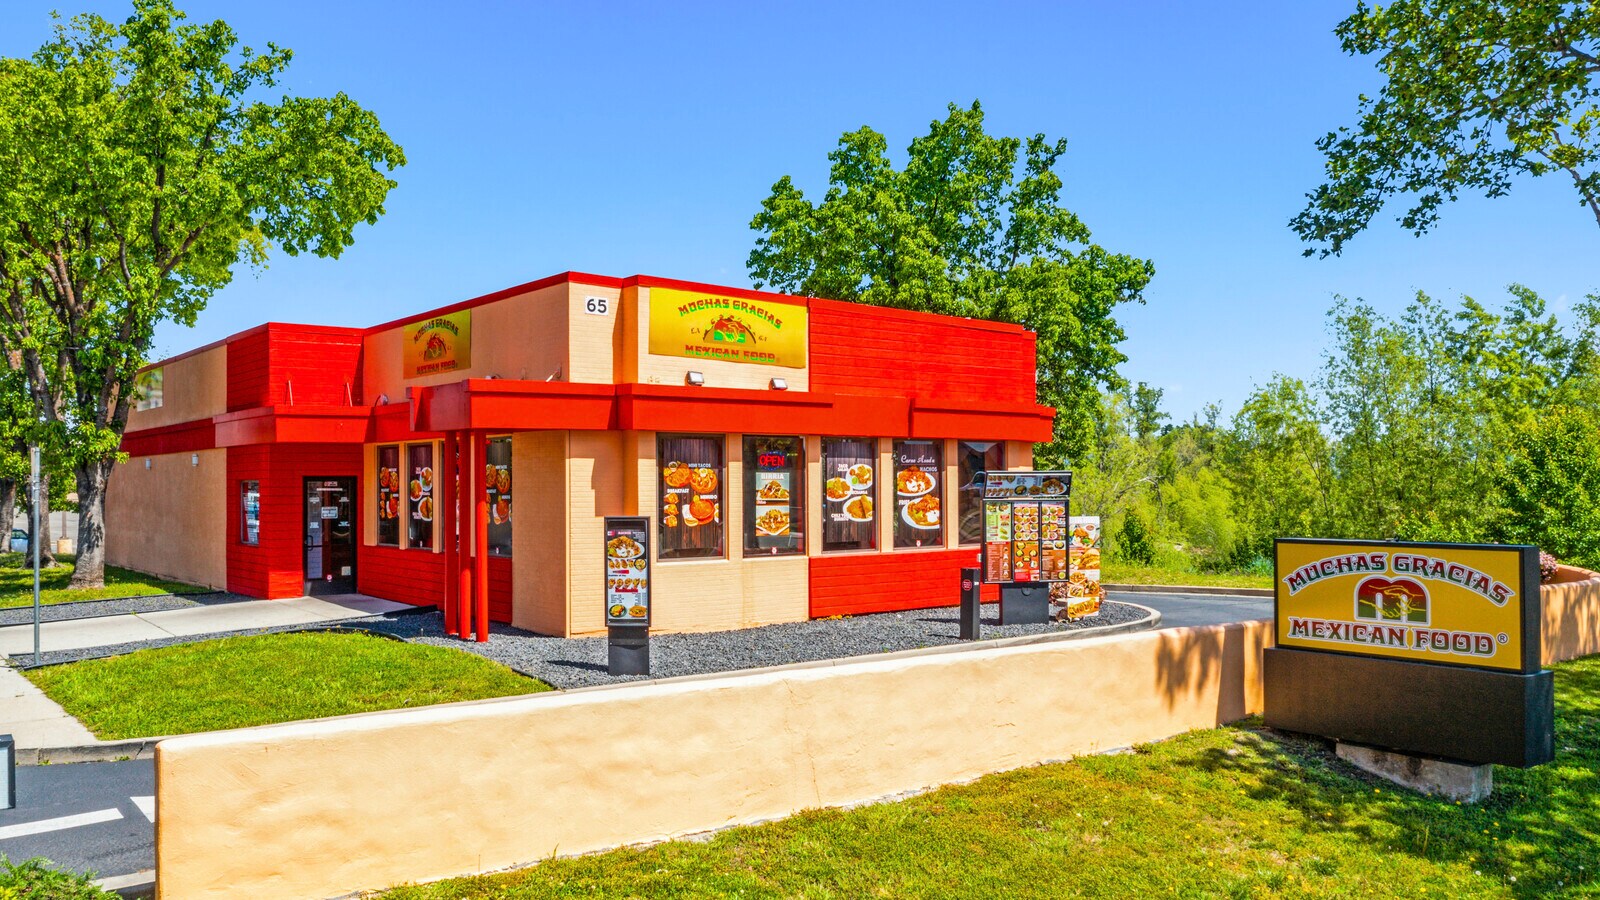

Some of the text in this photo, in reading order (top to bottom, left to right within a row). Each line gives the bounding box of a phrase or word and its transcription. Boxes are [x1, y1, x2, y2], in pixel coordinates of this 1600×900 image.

[587, 298, 607, 313] 65
[732, 300, 783, 329] GRACIAS
[685, 345, 776, 363] MEXICAN FOOD
[759, 454, 785, 467] OPEN
[1284, 552, 1515, 607] MUCHAS GRACIAS
[1288, 617, 1408, 648] MEXICAN
